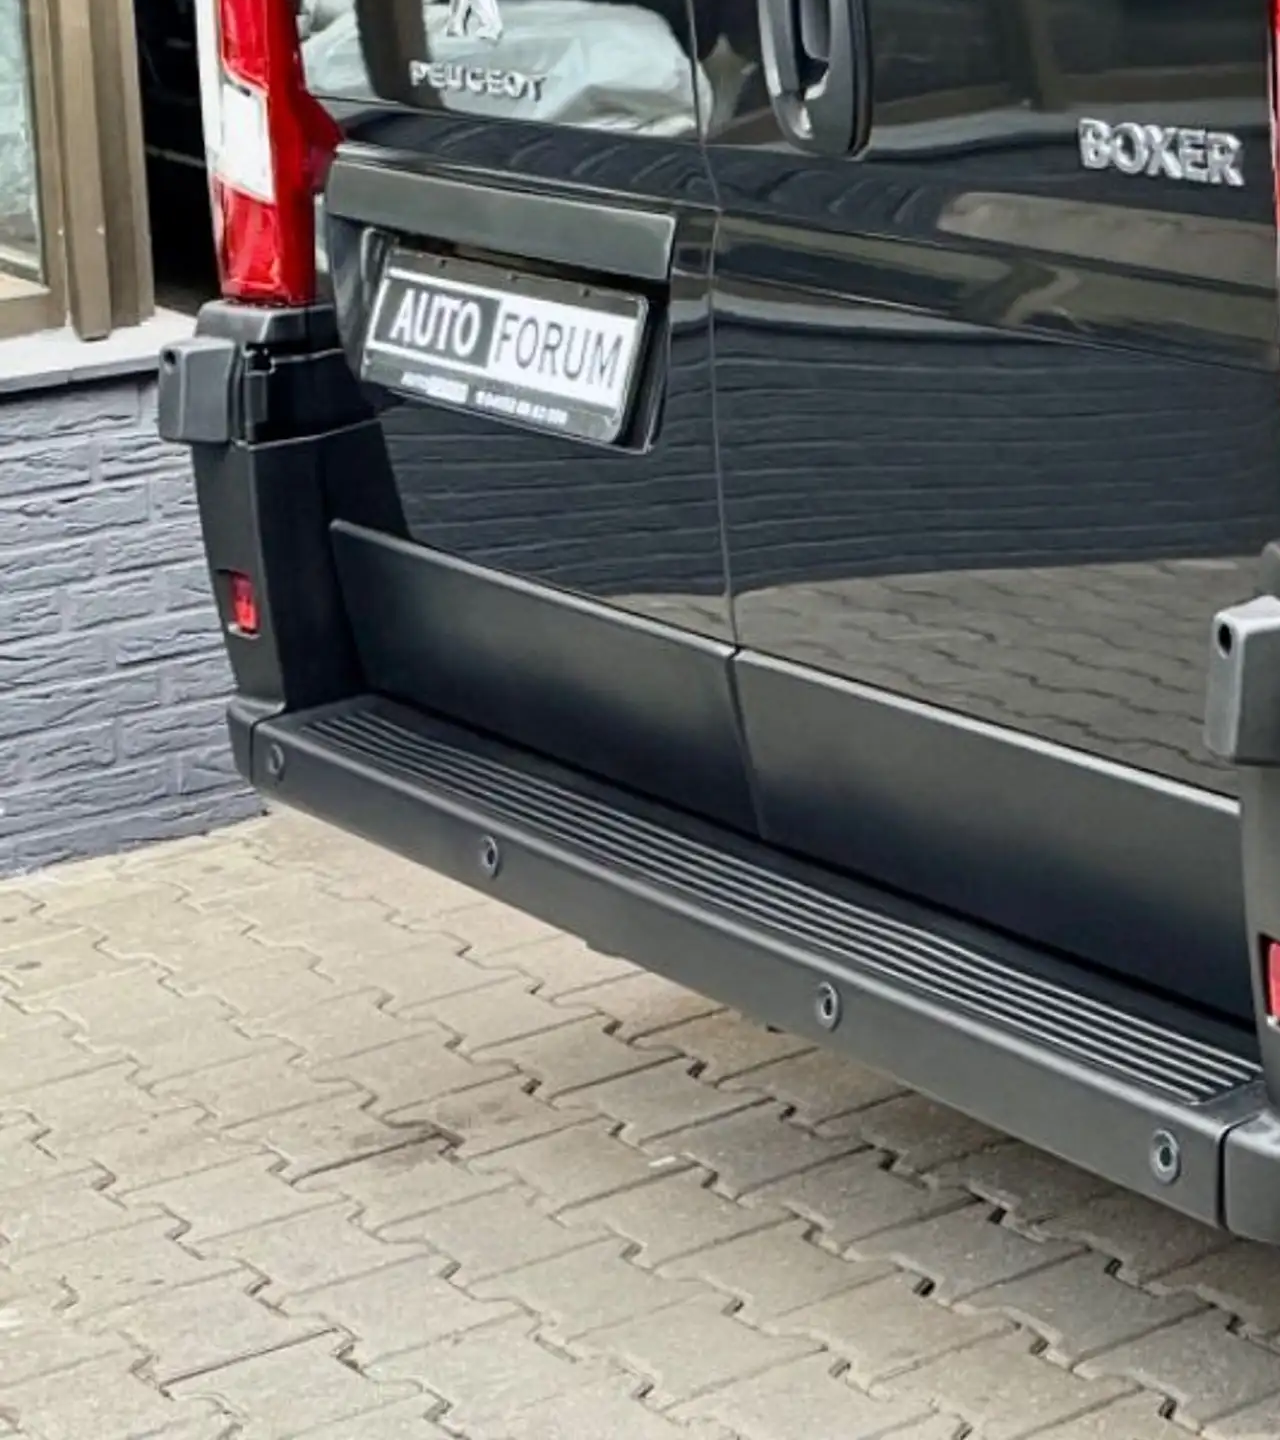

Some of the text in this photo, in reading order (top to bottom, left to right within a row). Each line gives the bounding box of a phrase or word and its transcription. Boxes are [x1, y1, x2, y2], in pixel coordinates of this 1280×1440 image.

[409, 60, 547, 102] PEUGEOT
[1078, 117, 1245, 187] BOXER
[388, 287, 482, 358] AUTO
[500, 312, 623, 390] FORUM
